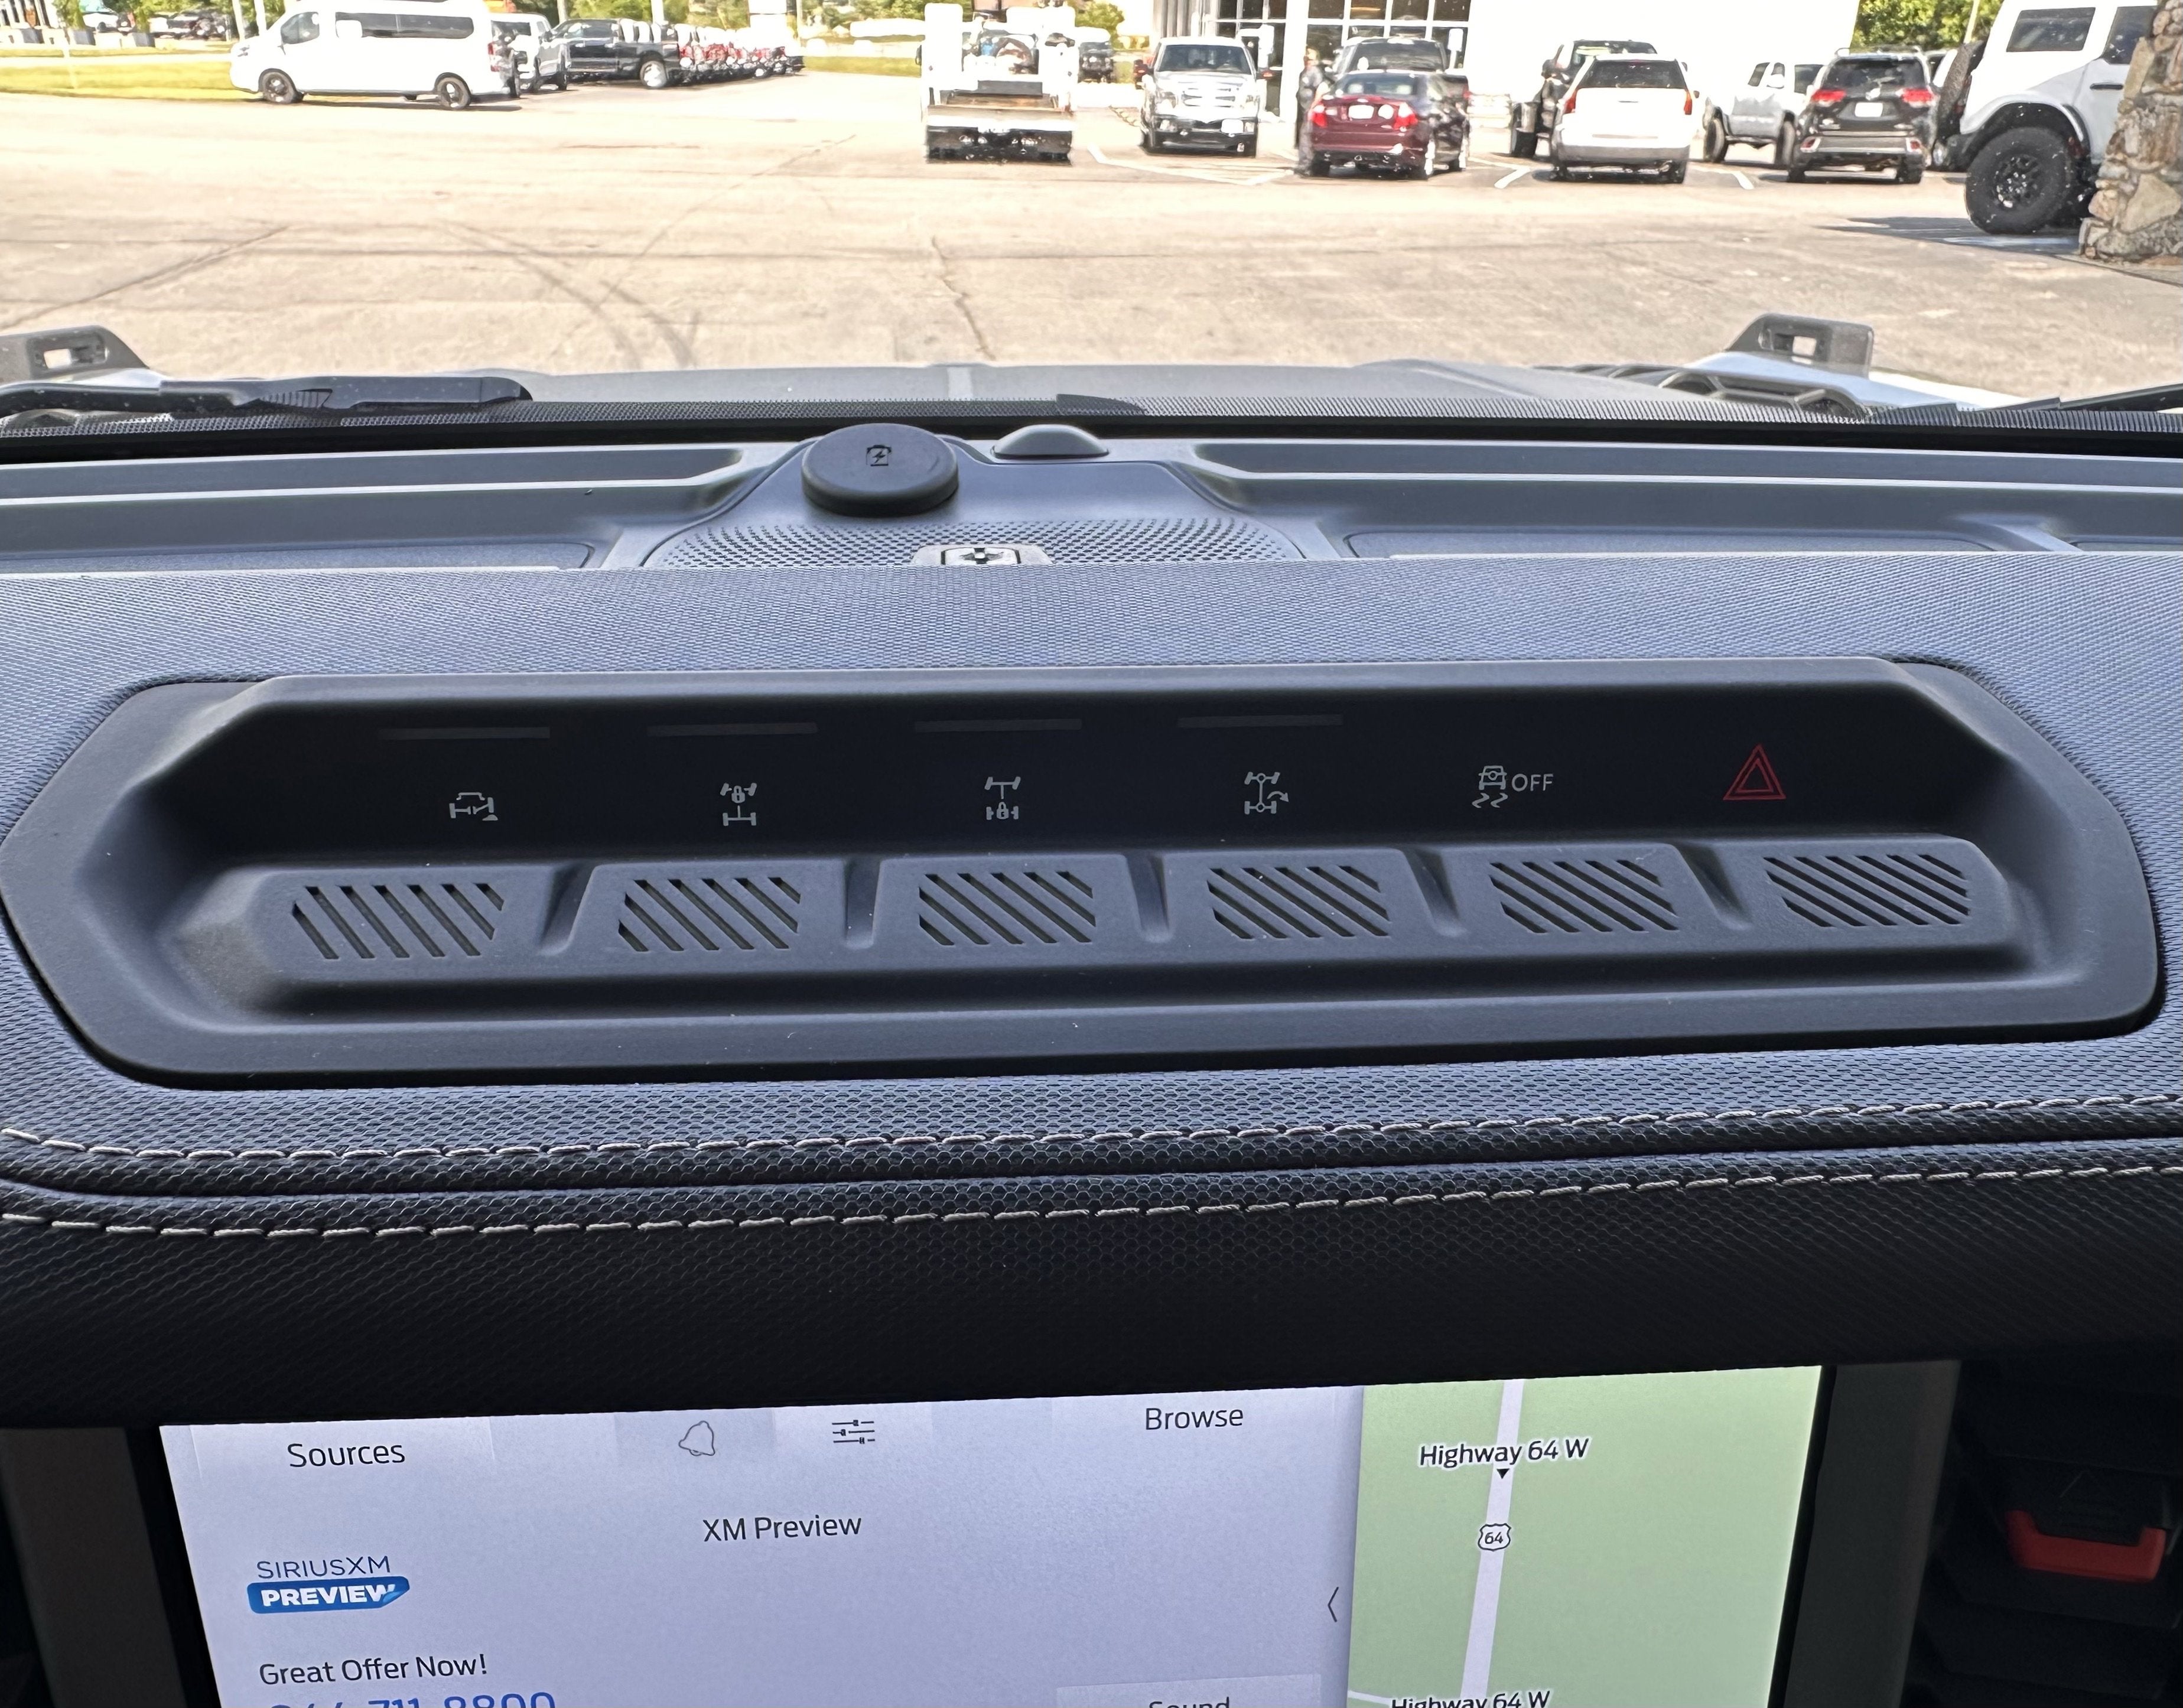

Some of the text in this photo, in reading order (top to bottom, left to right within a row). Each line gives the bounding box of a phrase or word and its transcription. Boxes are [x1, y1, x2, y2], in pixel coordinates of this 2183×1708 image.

[1511, 773, 1554, 792] OFF
[1145, 1407, 1244, 1431] Browse
[287, 1442, 406, 1468] Sources
[1420, 1438, 1589, 1469] Highway 64 W
[702, 1514, 863, 1542] XM Preview
[1484, 1531, 1504, 1544] 64
[256, 1555, 391, 1579] SIRIUSXM
[261, 1583, 396, 1607] PREVIEW
[259, 1654, 487, 1685] Great Offer Now!
[1493, 1692, 1522, 1708] 64
[1528, 1690, 1551, 1708] W
